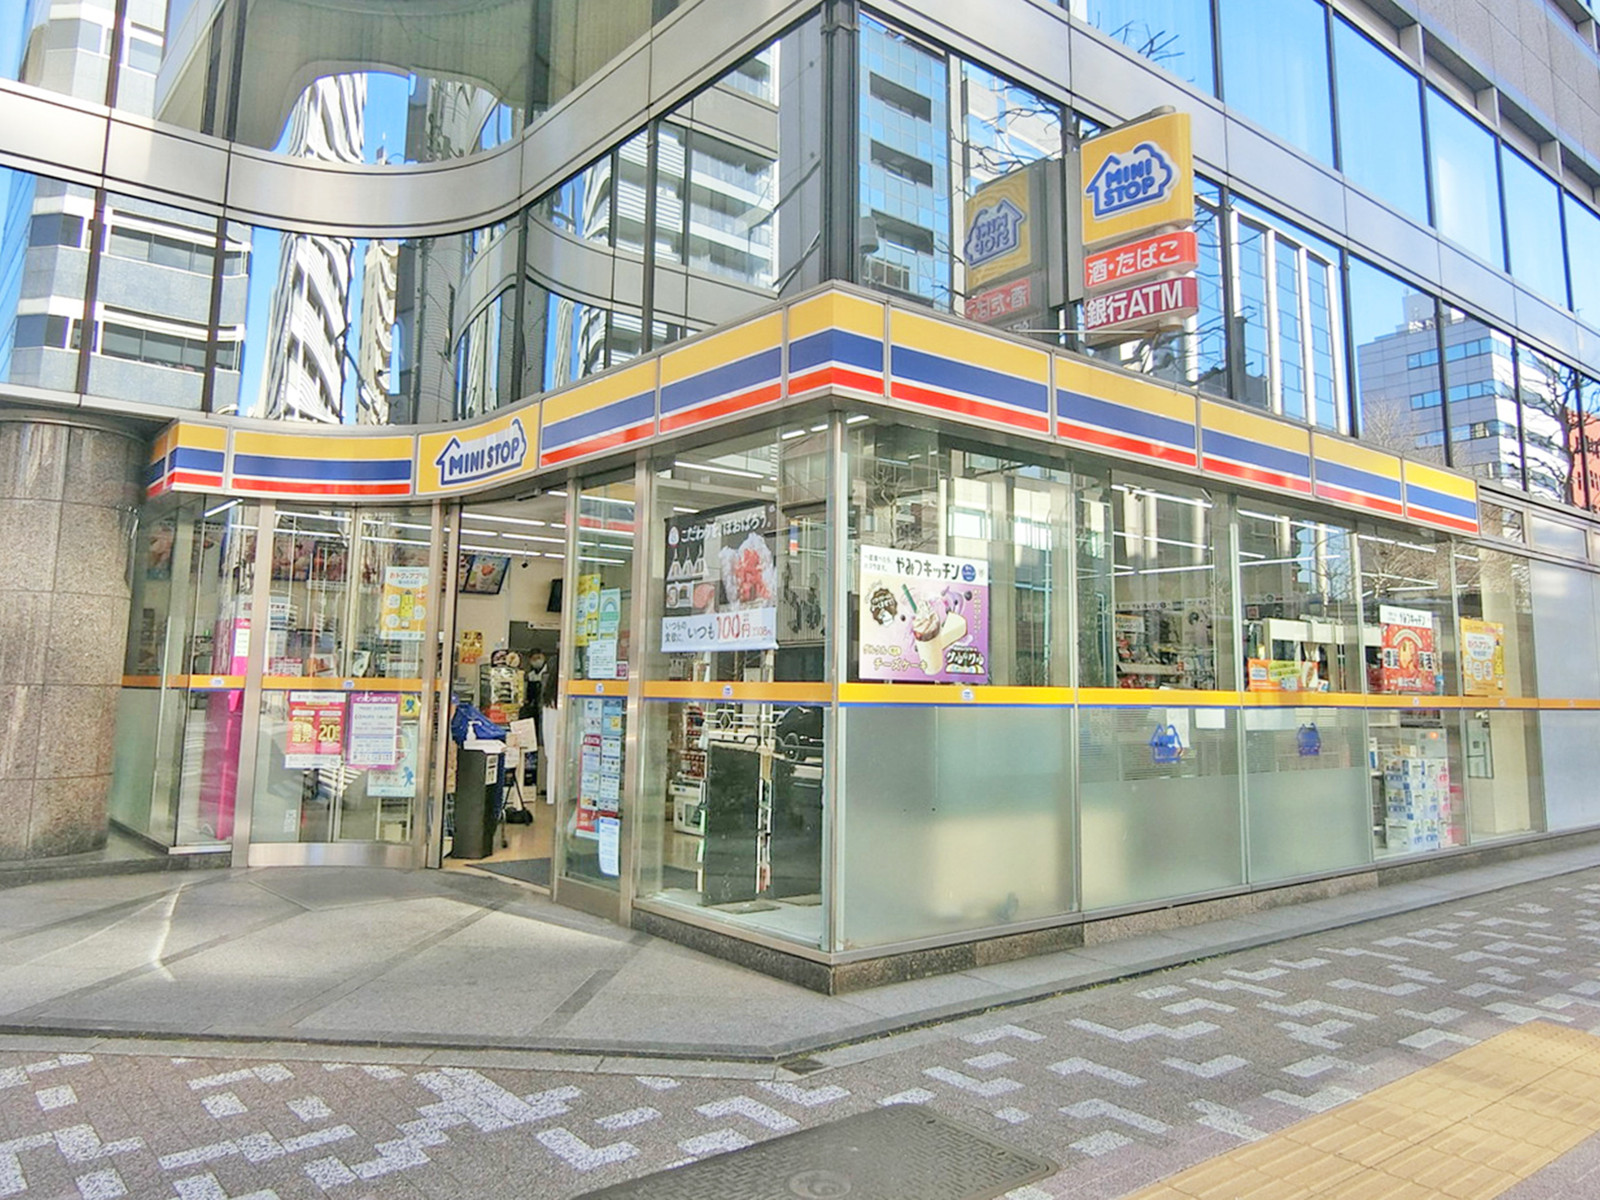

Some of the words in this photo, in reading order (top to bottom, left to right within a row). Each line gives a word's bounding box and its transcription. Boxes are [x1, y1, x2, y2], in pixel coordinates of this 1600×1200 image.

[1105, 158, 1153, 188] MINI
[1103, 176, 1156, 207] STOP
[1087, 240, 1181, 285] 酒・たばこ
[1086, 279, 1184, 328] 銀行ATM
[896, 556, 960, 580] やみつキッチン
